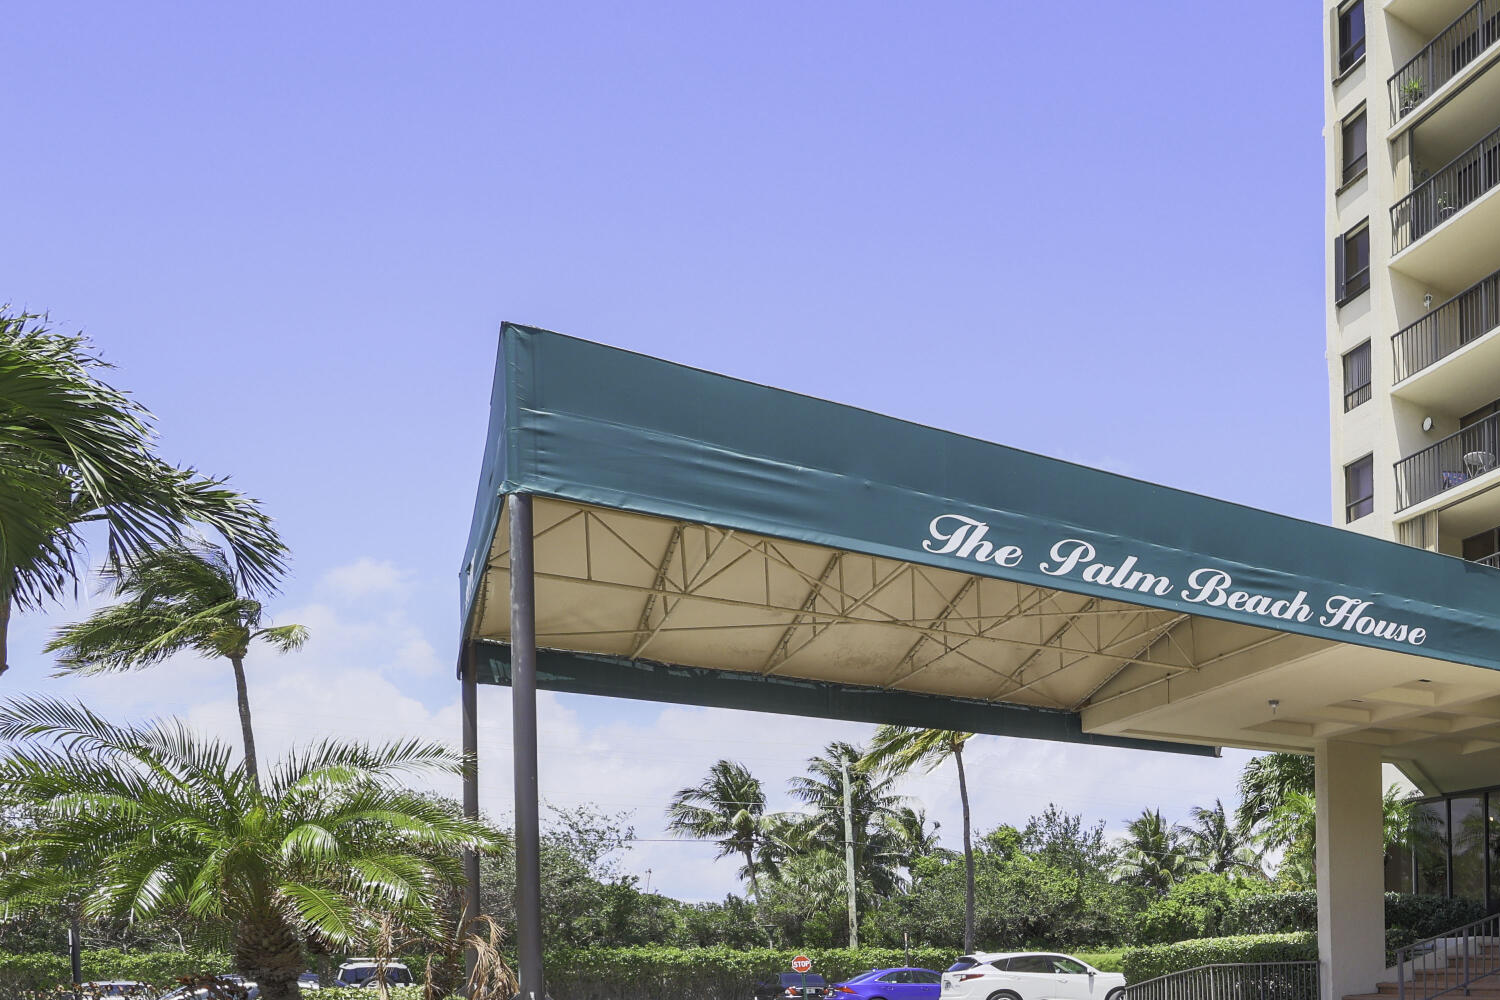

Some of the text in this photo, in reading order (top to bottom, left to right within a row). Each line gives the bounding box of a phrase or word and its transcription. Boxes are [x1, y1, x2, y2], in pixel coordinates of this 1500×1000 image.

[922, 514, 1426, 645] The Palm Beach House
[793, 960, 810, 968] STOP
